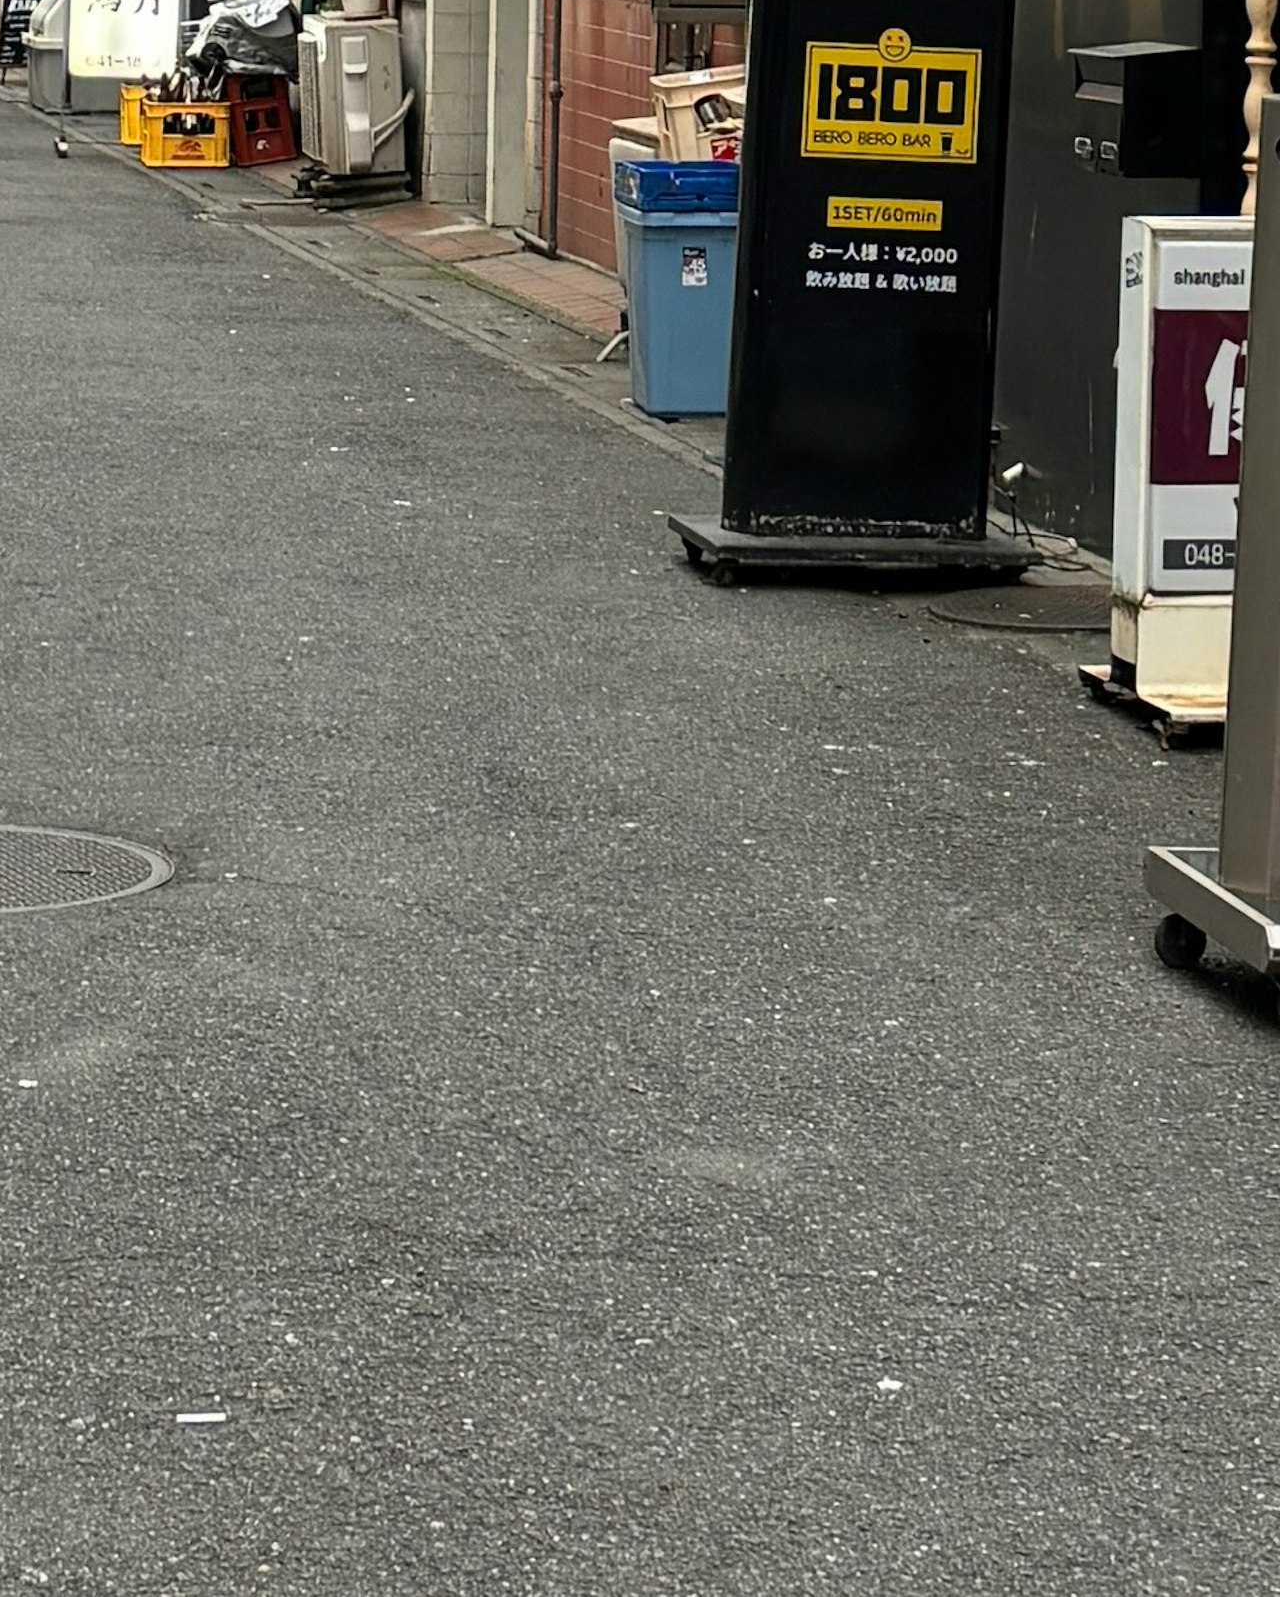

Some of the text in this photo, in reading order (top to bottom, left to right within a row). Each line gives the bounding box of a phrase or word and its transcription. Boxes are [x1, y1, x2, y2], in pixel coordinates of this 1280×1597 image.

[816, 63, 968, 125] 1800
[813, 129, 932, 148] BERO BERO BAR
[832, 205, 938, 224] 1SET/60min
[805, 269, 958, 293] 飲み放題 & 歌い放題
